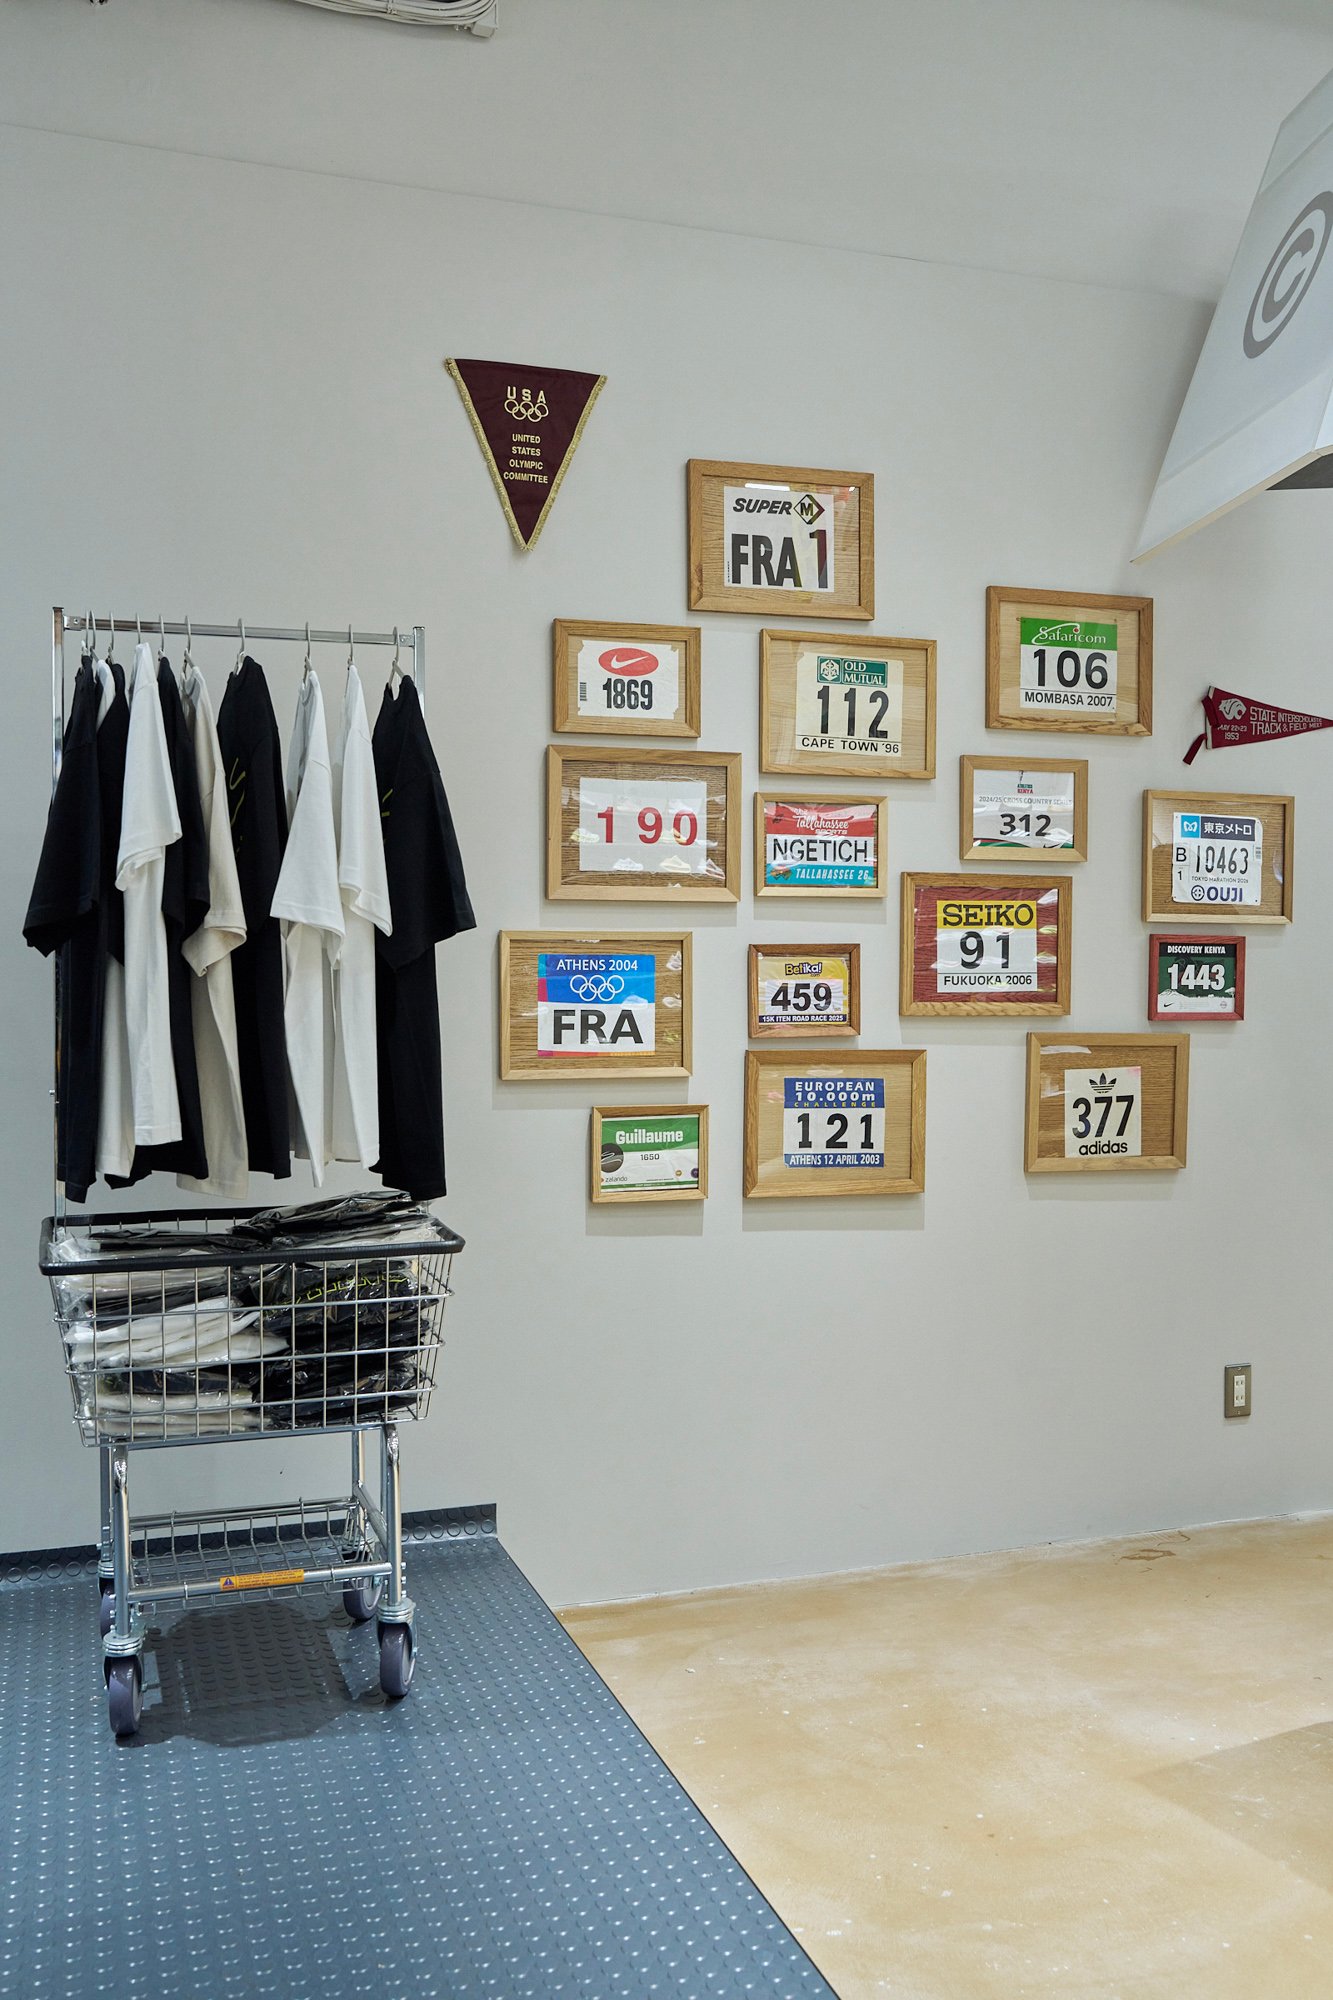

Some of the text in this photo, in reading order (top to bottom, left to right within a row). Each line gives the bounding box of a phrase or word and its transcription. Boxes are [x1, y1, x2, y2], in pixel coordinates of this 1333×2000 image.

[507, 386, 547, 404] USA
[512, 433, 541, 444] UNITED
[511, 446, 541, 456] STATES
[509, 459, 544, 470] OLYMPIC
[503, 471, 548, 484] COMMITTEE
[732, 497, 793, 515] SUPER
[731, 529, 828, 588] FRA 1
[1038, 625, 1107, 645] Safaricom
[844, 661, 867, 672] OLD
[1033, 648, 1109, 690] 106
[843, 673, 884, 685] MUTUAL
[602, 677, 654, 711] 1869
[1024, 691, 1113, 707] MOMBASA 2007
[817, 685, 890, 739] 112
[1249, 706, 1277, 723] STATE
[1251, 720, 1282, 736] TRACK
[1282, 722, 1289, 733] &
[1289, 722, 1307, 732] FIELD
[801, 737, 835, 749] CAPE
[841, 740, 878, 752] TOWN
[1224, 732, 1240, 741] 1953
[979, 795, 1003, 804] 2024/25
[1023, 797, 1053, 806] COUNTRY
[597, 806, 698, 846] 190
[792, 815, 849, 831] Tallahassee
[1000, 813, 1051, 837] 312
[1203, 822, 1252, 836] 東京メトロ
[773, 838, 867, 863] NGETICH
[1176, 847, 1187, 862] B
[1196, 845, 1249, 875] 10463
[795, 868, 855, 881] TALLAHASSEE
[1178, 870, 1182, 880] 1
[1209, 876, 1237, 884] MARATHON
[1206, 886, 1243, 902] OUJI
[943, 903, 1034, 927] SEIKO
[960, 931, 1010, 969] 91
[1167, 945, 1226, 954] DISCOVERY KENYA
[556, 959, 638, 971] ATHENS 2004
[785, 962, 822, 975] Betika!
[944, 975, 1032, 986] FUKUOKA 2006
[1167, 963, 1226, 991] 1443
[770, 982, 832, 1012] 459
[552, 1009, 644, 1045] FRA
[794, 1081, 875, 1091] EUROPEAN
[795, 1092, 875, 1101] 10.000m
[1072, 1095, 1134, 1138] 377
[615, 1128, 684, 1145] Guillaume
[797, 1112, 874, 1149] 121
[1078, 1140, 1128, 1155] adidas
[640, 1153, 660, 1161] 1650
[789, 1154, 880, 1165] ATHENS 12 APRIL 2003
